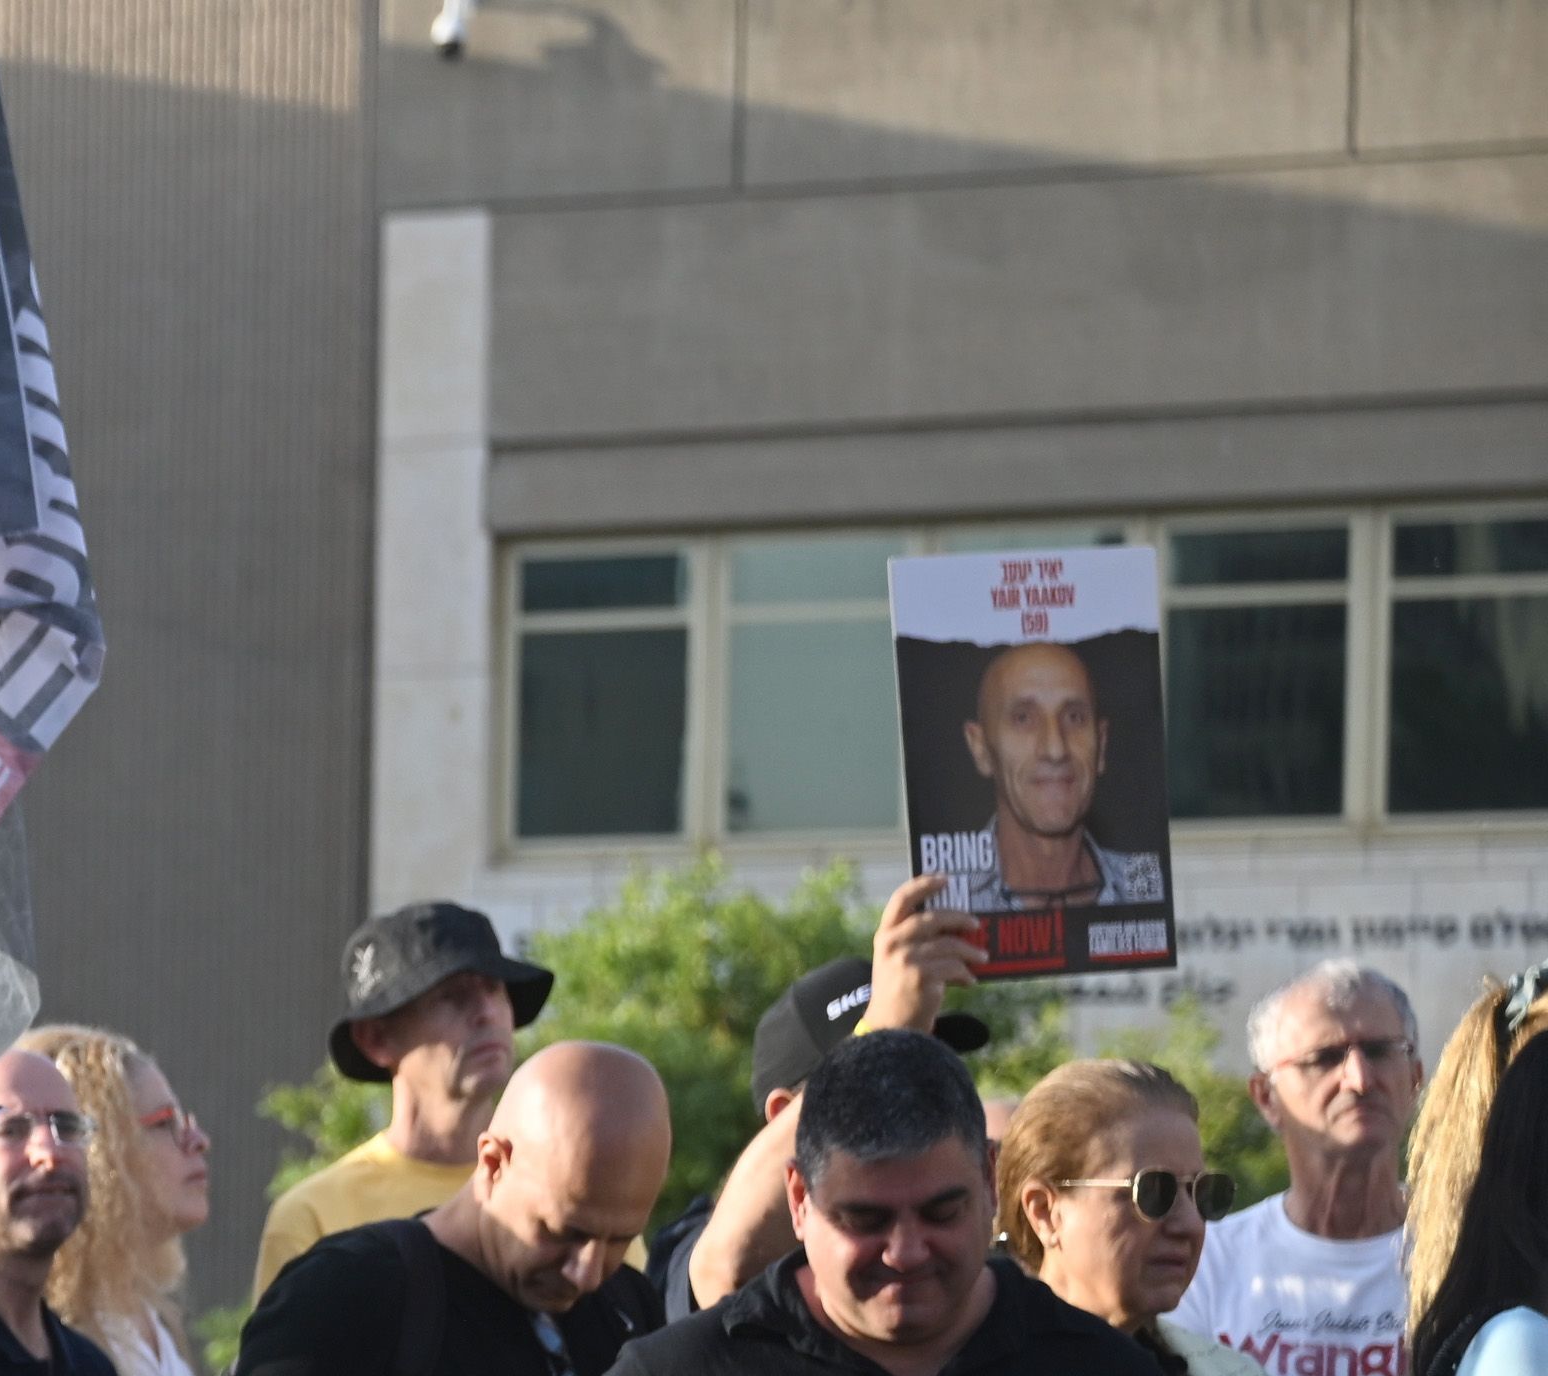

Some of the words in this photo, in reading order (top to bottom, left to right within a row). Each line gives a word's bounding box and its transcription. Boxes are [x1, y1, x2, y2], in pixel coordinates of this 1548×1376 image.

[991, 586, 1021, 610] YAIR
[1024, 583, 1076, 608] YAAKOV
[920, 830, 994, 872] BRING
[998, 908, 1064, 955] NOW!
[826, 983, 872, 1021] SKE
